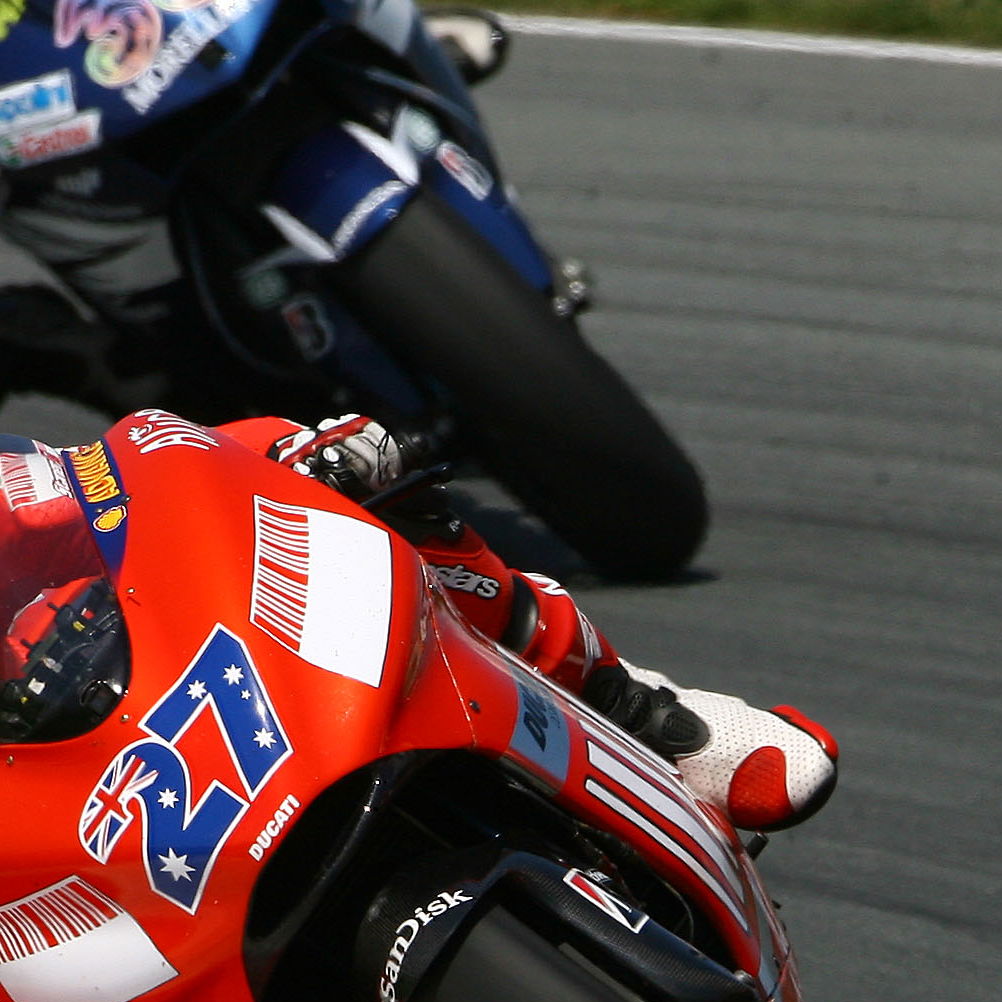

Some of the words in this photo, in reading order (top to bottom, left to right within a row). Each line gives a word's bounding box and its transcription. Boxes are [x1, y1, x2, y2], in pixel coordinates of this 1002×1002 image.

[430, 564, 500, 599] stars
[78, 622, 294, 915] 27
[248, 794, 301, 862] DUCATI
